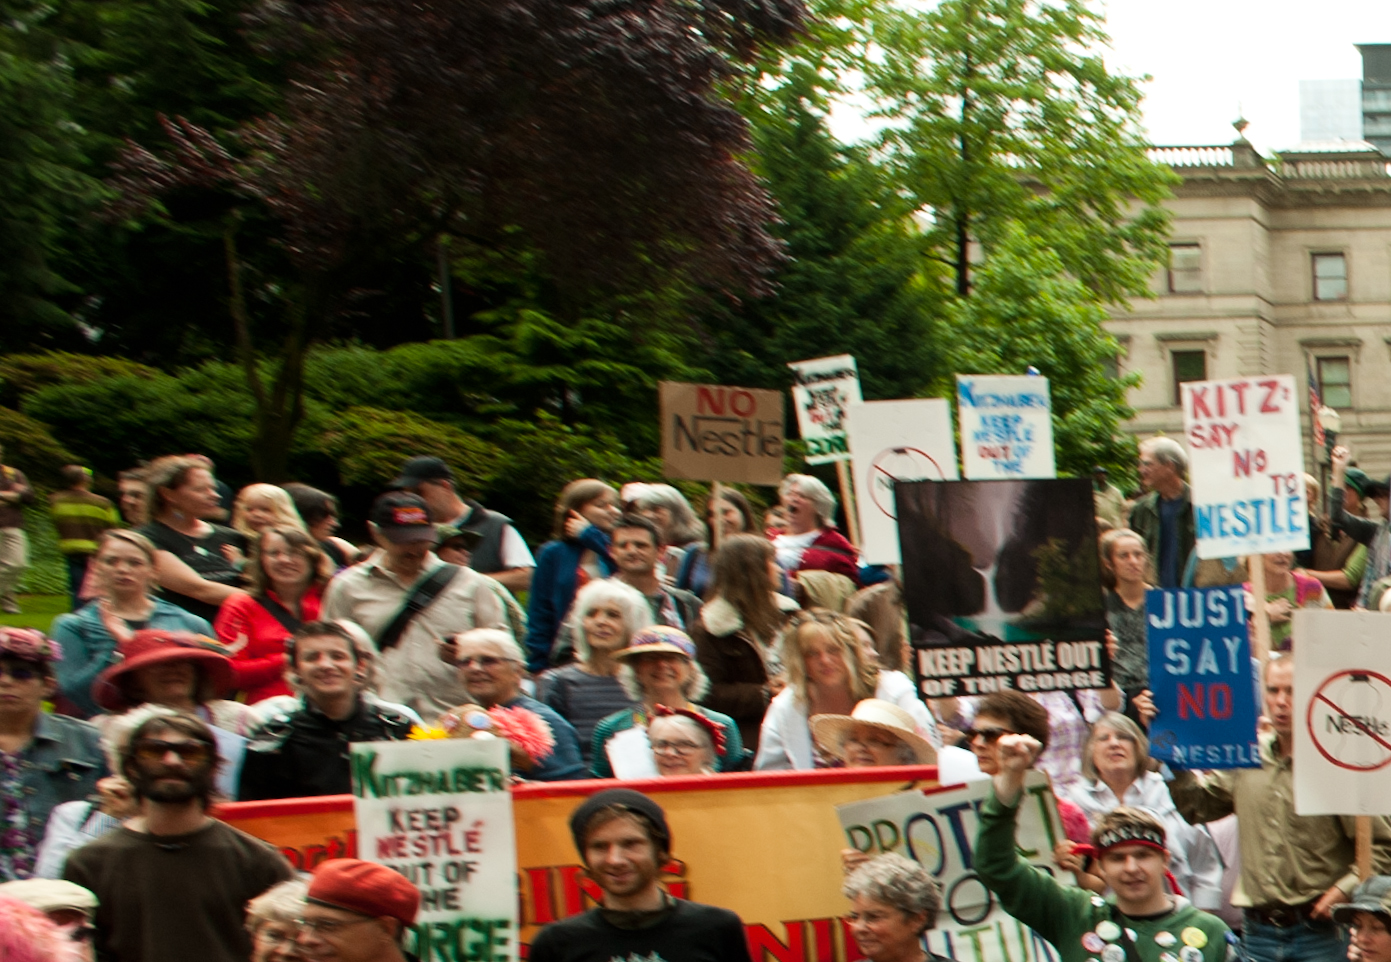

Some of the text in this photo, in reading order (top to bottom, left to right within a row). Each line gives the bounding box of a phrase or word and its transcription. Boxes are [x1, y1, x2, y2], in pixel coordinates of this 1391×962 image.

[697, 386, 757, 418] NO
[979, 413, 1023, 429] KEEP
[1190, 423, 1238, 449] SAY
[978, 445, 1010, 460] OUT
[1233, 449, 1268, 478] NO
[1271, 473, 1298, 496] TO
[1194, 496, 1303, 540] NESTLE
[1150, 588, 1247, 629] JUST
[918, 639, 1102, 677] KEEP NESTLÉ OUT
[1164, 636, 1241, 675] SAY
[921, 670, 1106, 696] OF THE GORGE
[1177, 683, 1233, 720] NO
[1171, 744, 1262, 766] NESTLE
[351, 750, 505, 798] KITZHABER
[389, 807, 461, 832] KEEP
[443, 860, 480, 884] OF
[419, 887, 462, 912] HE
